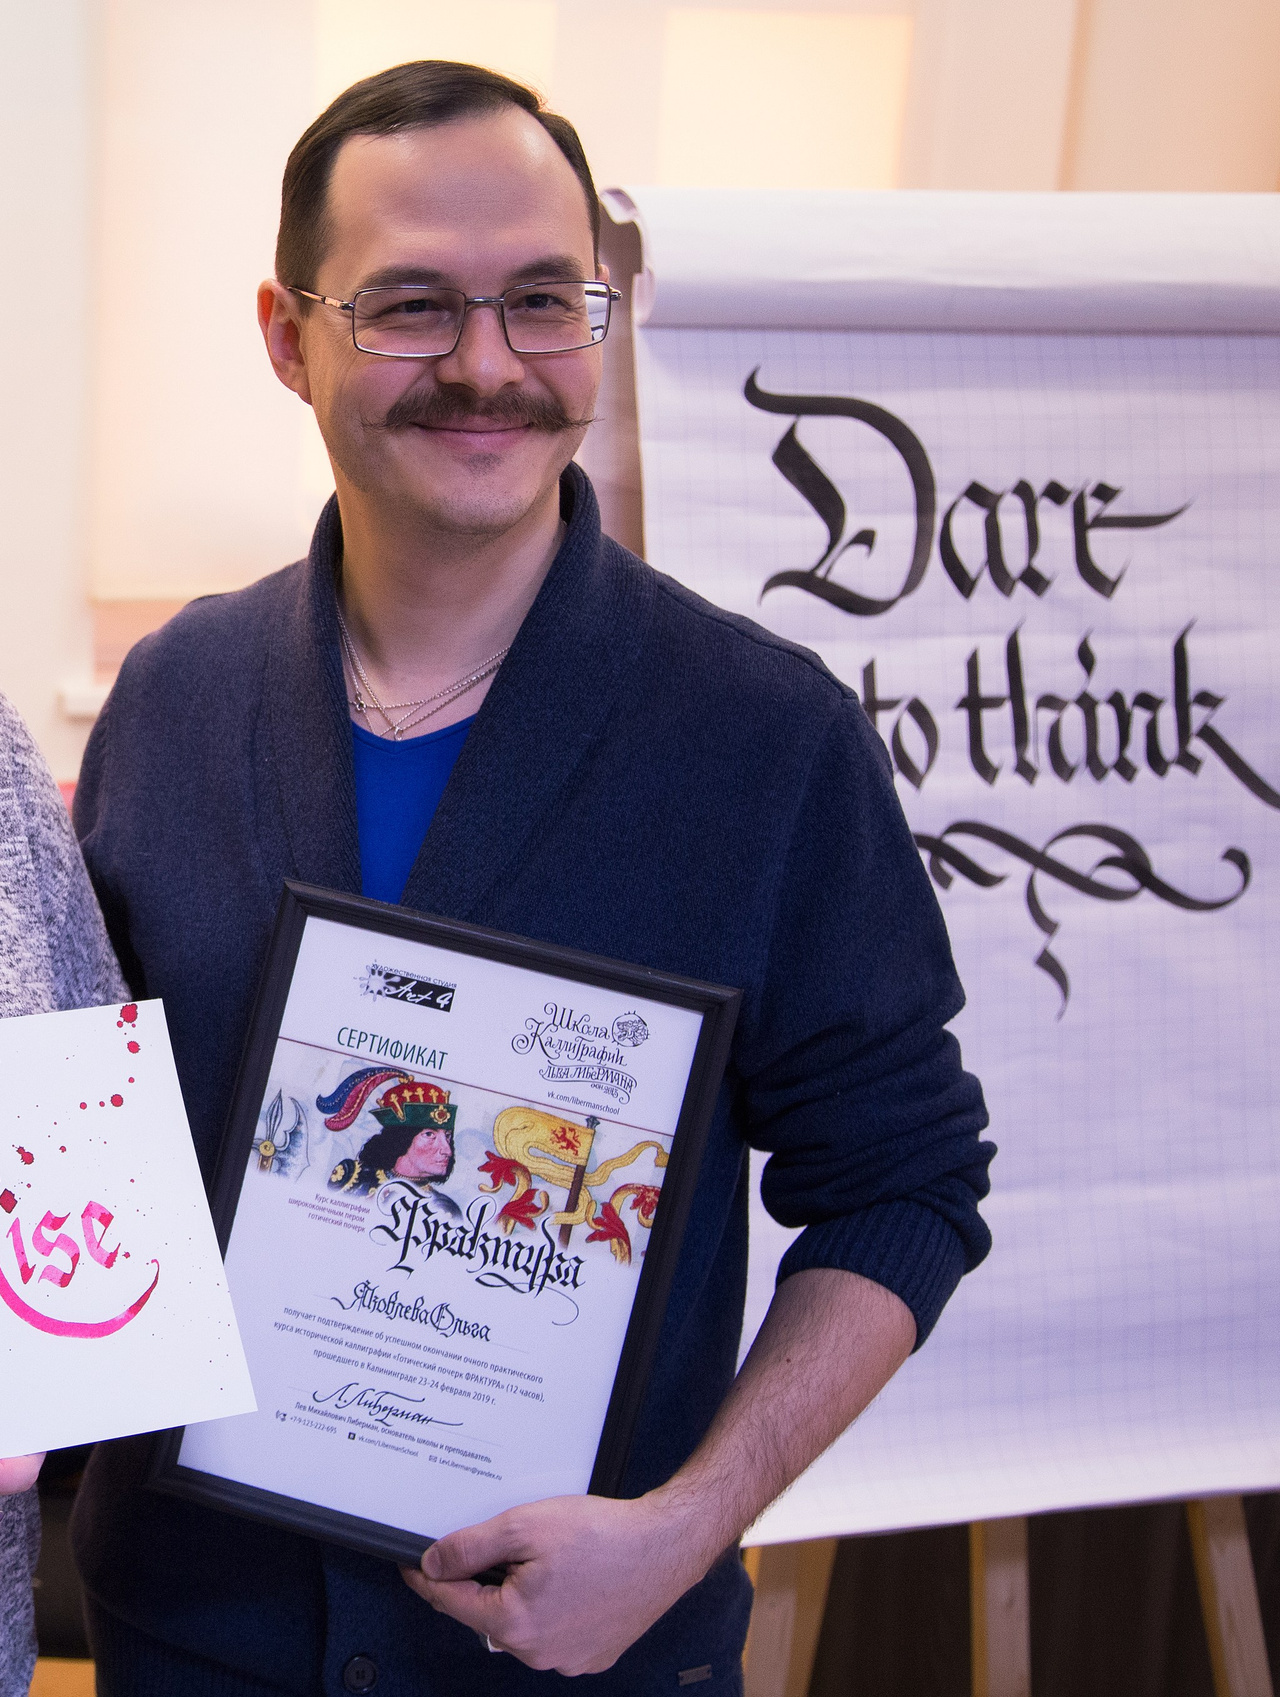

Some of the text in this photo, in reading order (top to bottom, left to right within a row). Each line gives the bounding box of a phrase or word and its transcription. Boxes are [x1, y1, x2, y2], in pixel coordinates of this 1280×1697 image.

[743, 366, 1196, 616] Dare
[957, 620, 1280, 810] think
[337, 1027, 448, 1070] СЕРТИФИКАТ
[547, 1090, 621, 1115] vk.com/libermanschool
[288, 1197, 365, 1223] ширококонечным пером
[315, 1193, 371, 1214] Курс каллиграфии
[343, 1221, 366, 1233] почерк
[273, 1321, 545, 1403] курса исторической каллиграфии «Готический почерк ФРАКТУРА» (12 часов),
[283, 1307, 544, 1384] получает подтверждение об успешном окончании очного практического
[313, 1349, 359, 1368] прошедшего
[366, 1362, 418, 1384] Калининграде
[440, 1382, 471, 1399] февраля
[472, 1391, 491, 1404] 2019
[294, 1402, 307, 1411] Лев
[307, 1405, 346, 1422] Михайлович
[346, 1416, 380, 1433] Либерман,
[380, 1427, 416, 1442] основатель
[416, 1437, 439, 1448] школы
[444, 1445, 492, 1463] преподаватель
